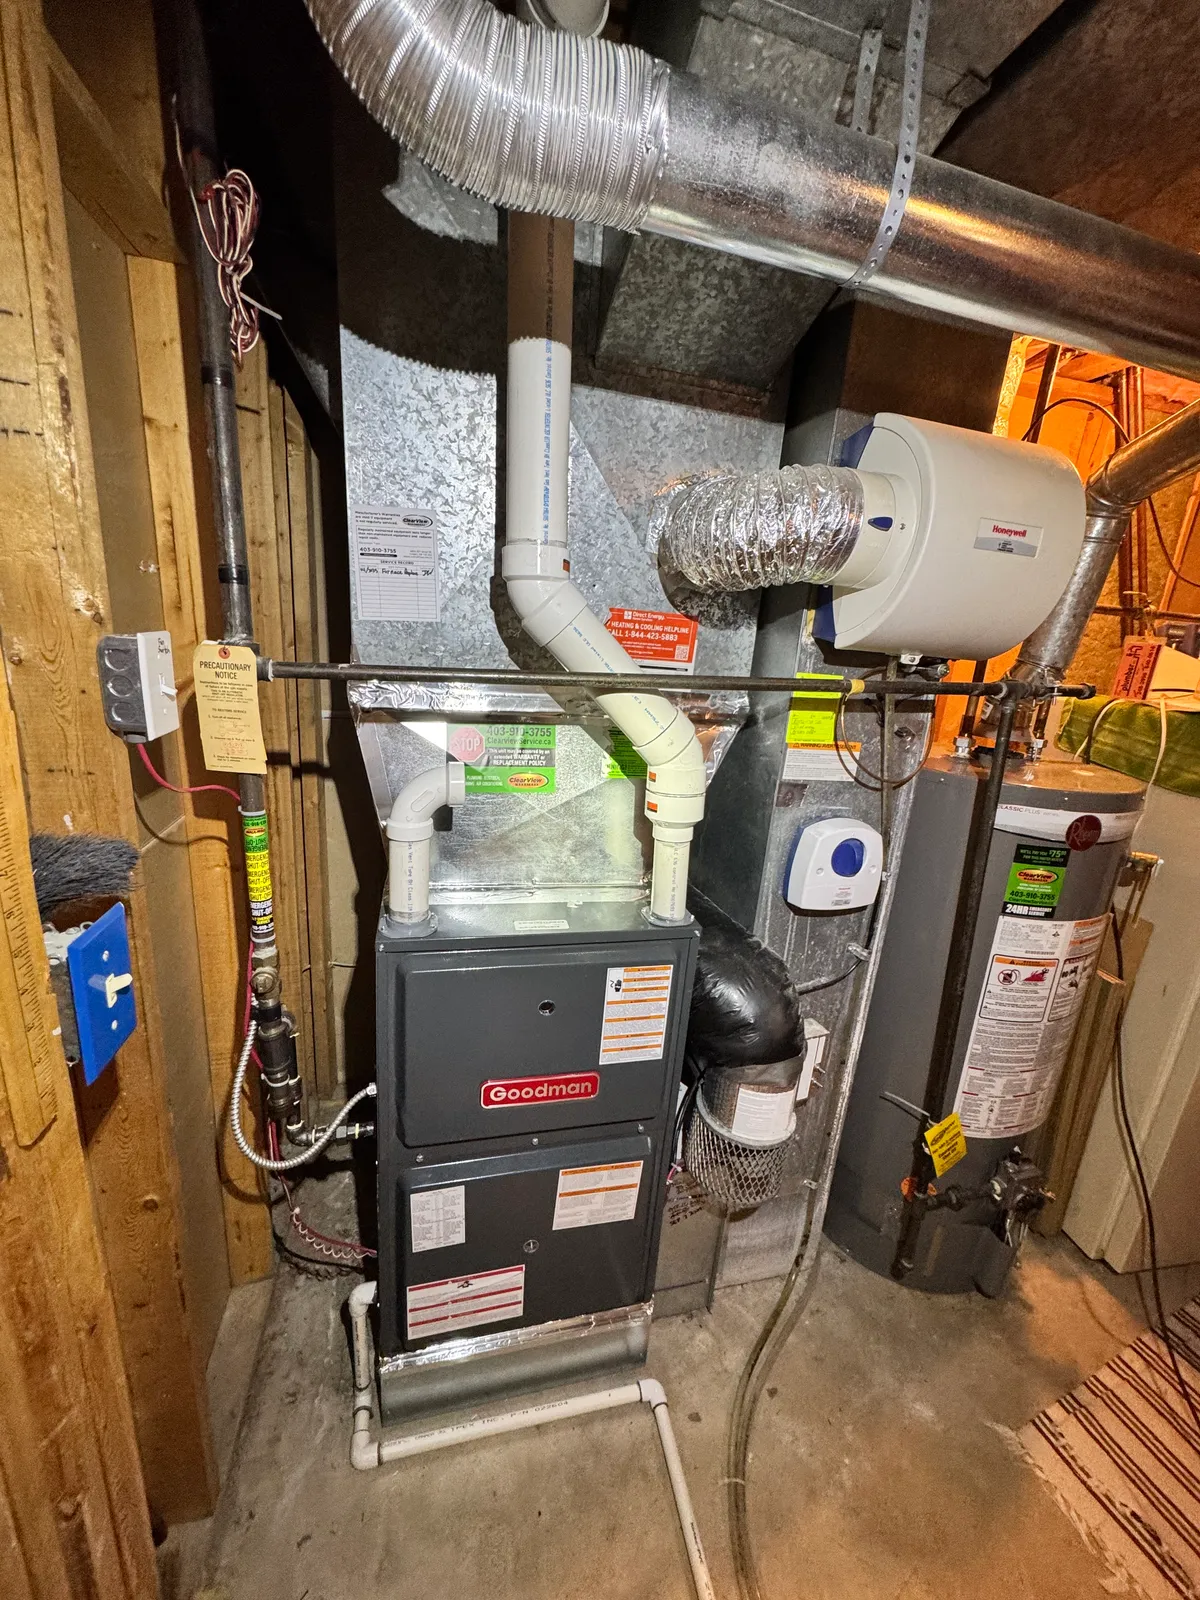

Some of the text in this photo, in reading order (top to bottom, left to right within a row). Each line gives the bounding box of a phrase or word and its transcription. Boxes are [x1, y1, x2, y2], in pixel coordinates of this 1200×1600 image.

[992, 524, 1027, 537] Honeywell
[611, 621, 634, 629] HEATING
[640, 623, 663, 632] COOLING
[664, 626, 689, 634] HELPLINE
[625, 630, 678, 641] 1-844-423-5883
[200, 661, 251, 671] PRECAUTIONARY
[215, 671, 237, 679] NOTICE
[1121, 662, 1135, 691] plumber
[486, 726, 552, 737] 403-910-3755
[452, 737, 481, 752] STOP
[1017, 871, 1053, 879] ClearView
[1009, 890, 1056, 900] 403-910-3755
[1005, 903, 1029, 915] 24HR
[490, 1080, 592, 1102] Goodman
